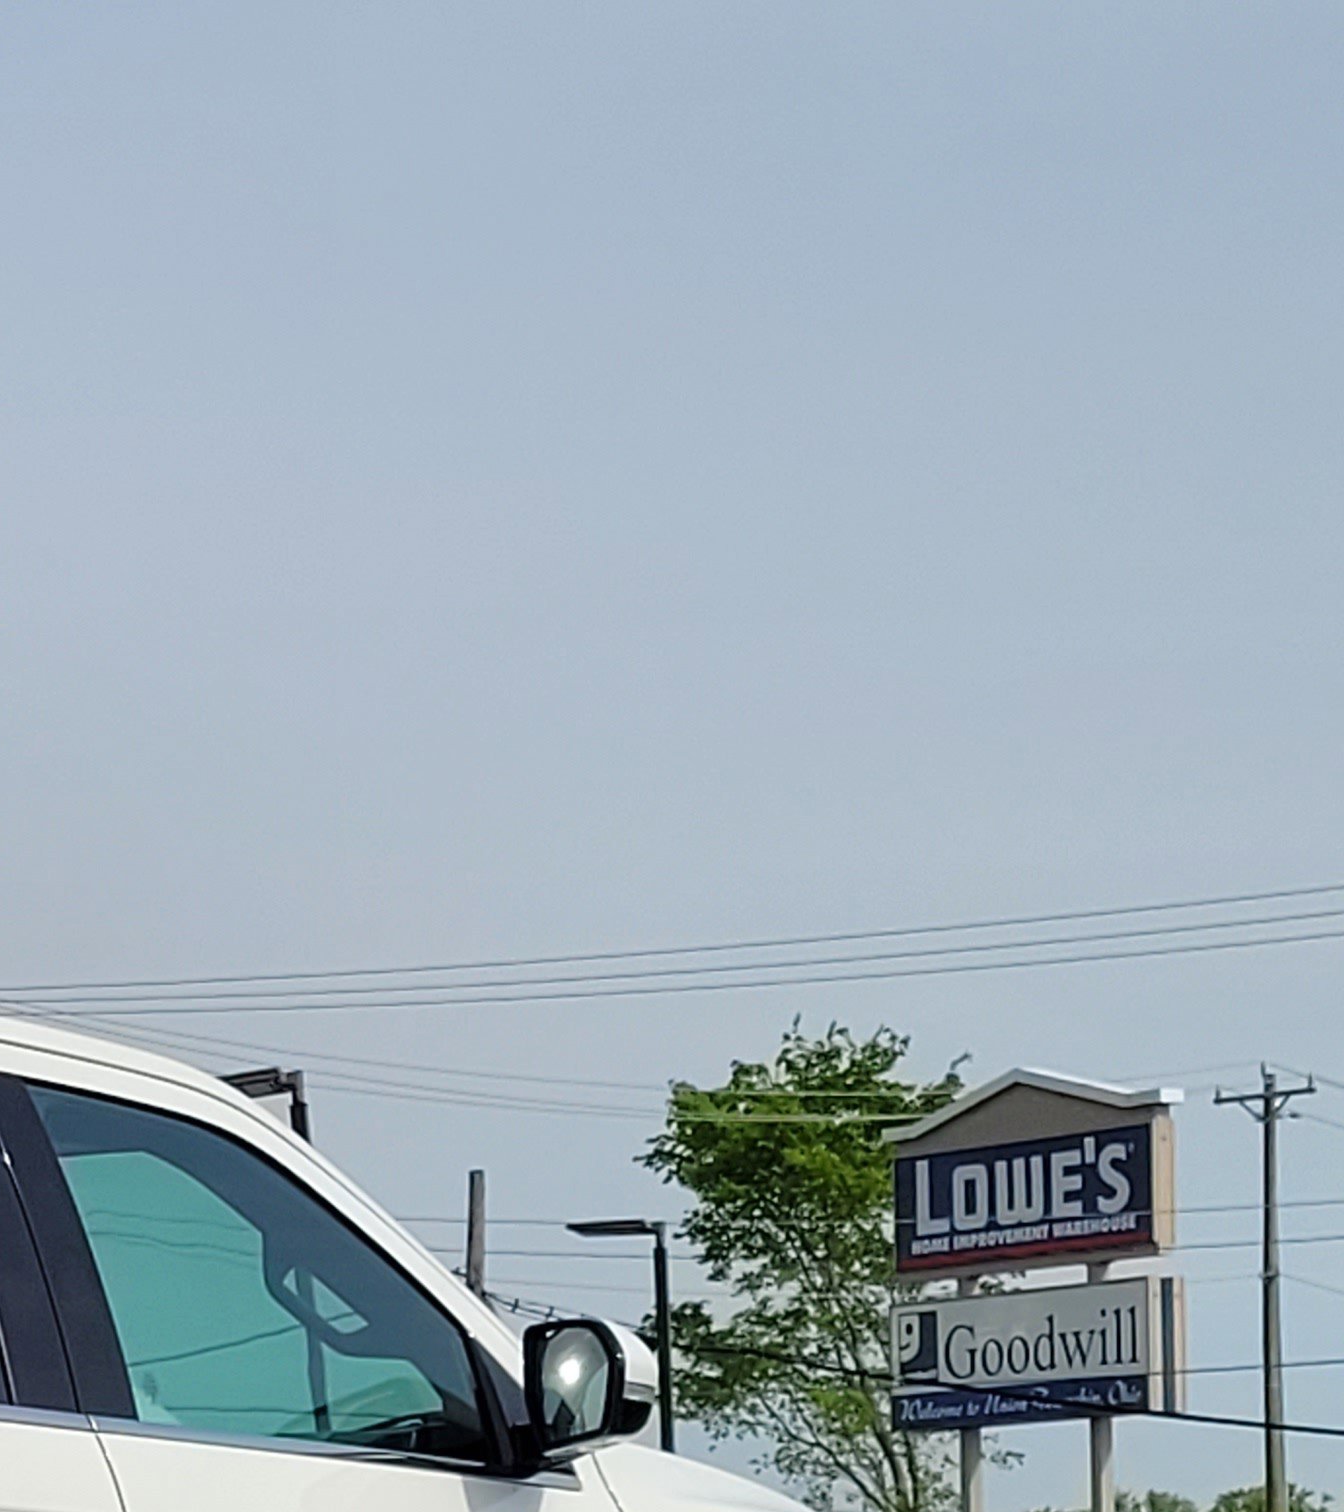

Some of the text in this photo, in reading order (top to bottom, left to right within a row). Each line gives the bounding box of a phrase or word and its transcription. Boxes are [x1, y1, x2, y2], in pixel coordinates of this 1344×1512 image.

[915, 1135, 1132, 1237] LOWE'S
[911, 1213, 1137, 1256] HOME IMPROVEMENT WAREHOUSE
[944, 1305, 1141, 1380] Goodwill
[900, 1399, 964, 1421] Welcome
[966, 1401, 981, 1417] to
